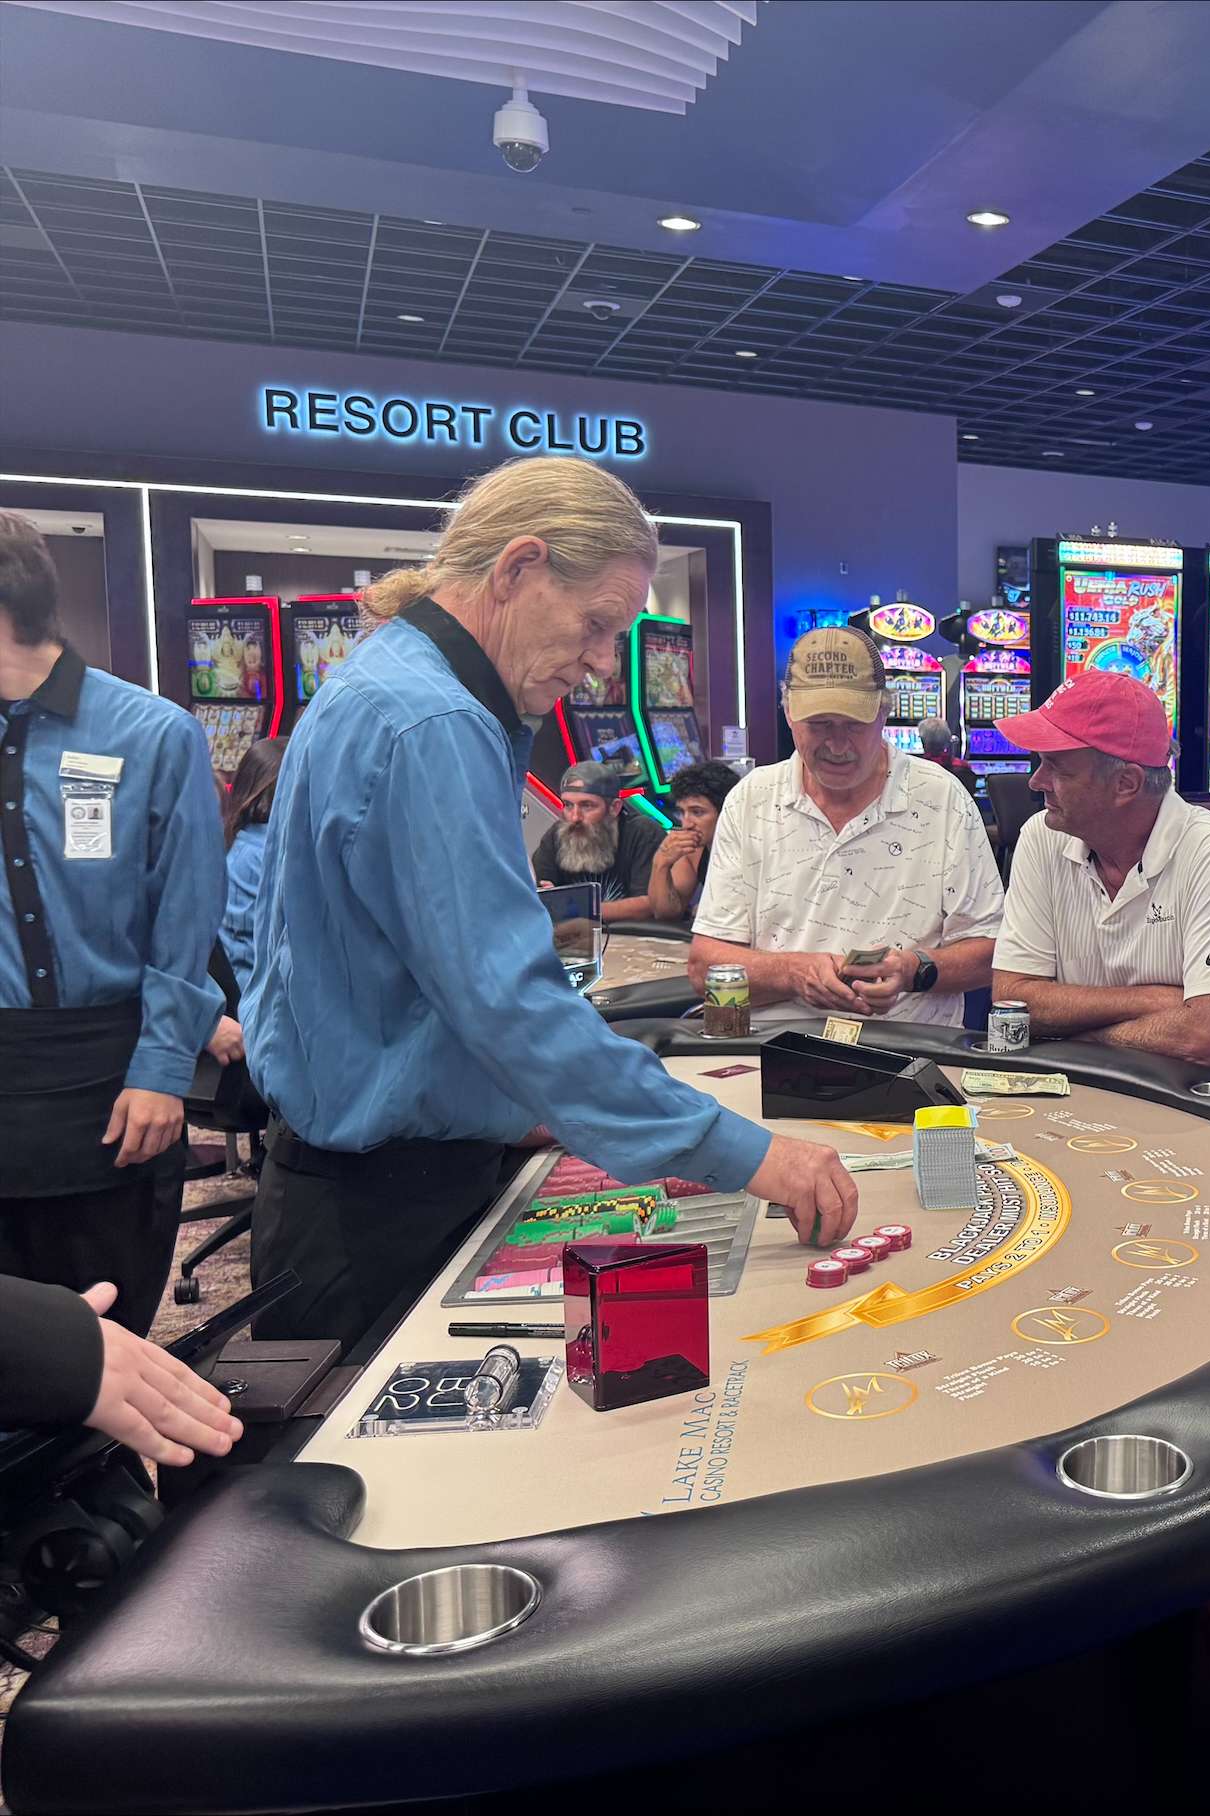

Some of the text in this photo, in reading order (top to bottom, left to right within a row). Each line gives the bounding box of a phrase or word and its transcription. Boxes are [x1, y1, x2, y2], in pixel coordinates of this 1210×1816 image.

[265, 389, 645, 455] RESORT CLUB
[1127, 581, 1168, 598] RUSH
[805, 662, 858, 677] CHAPTER
[807, 652, 847, 661] SECOND
[991, 1177, 1017, 1192] HIT
[1024, 1171, 1058, 1220] INSURANCE
[1000, 1194, 1021, 1220] MUST
[927, 1198, 994, 1261] BLACKJACK
[952, 1222, 1014, 1265] DEALER
[1015, 1237, 1043, 1251] TO
[1005, 1252, 1027, 1262] 2
[956, 1262, 1013, 1289] PAYS
[700, 1359, 750, 1502] CASINO RESORT & RACETRACK
[662, 1392, 717, 1504] LAKE MAC
